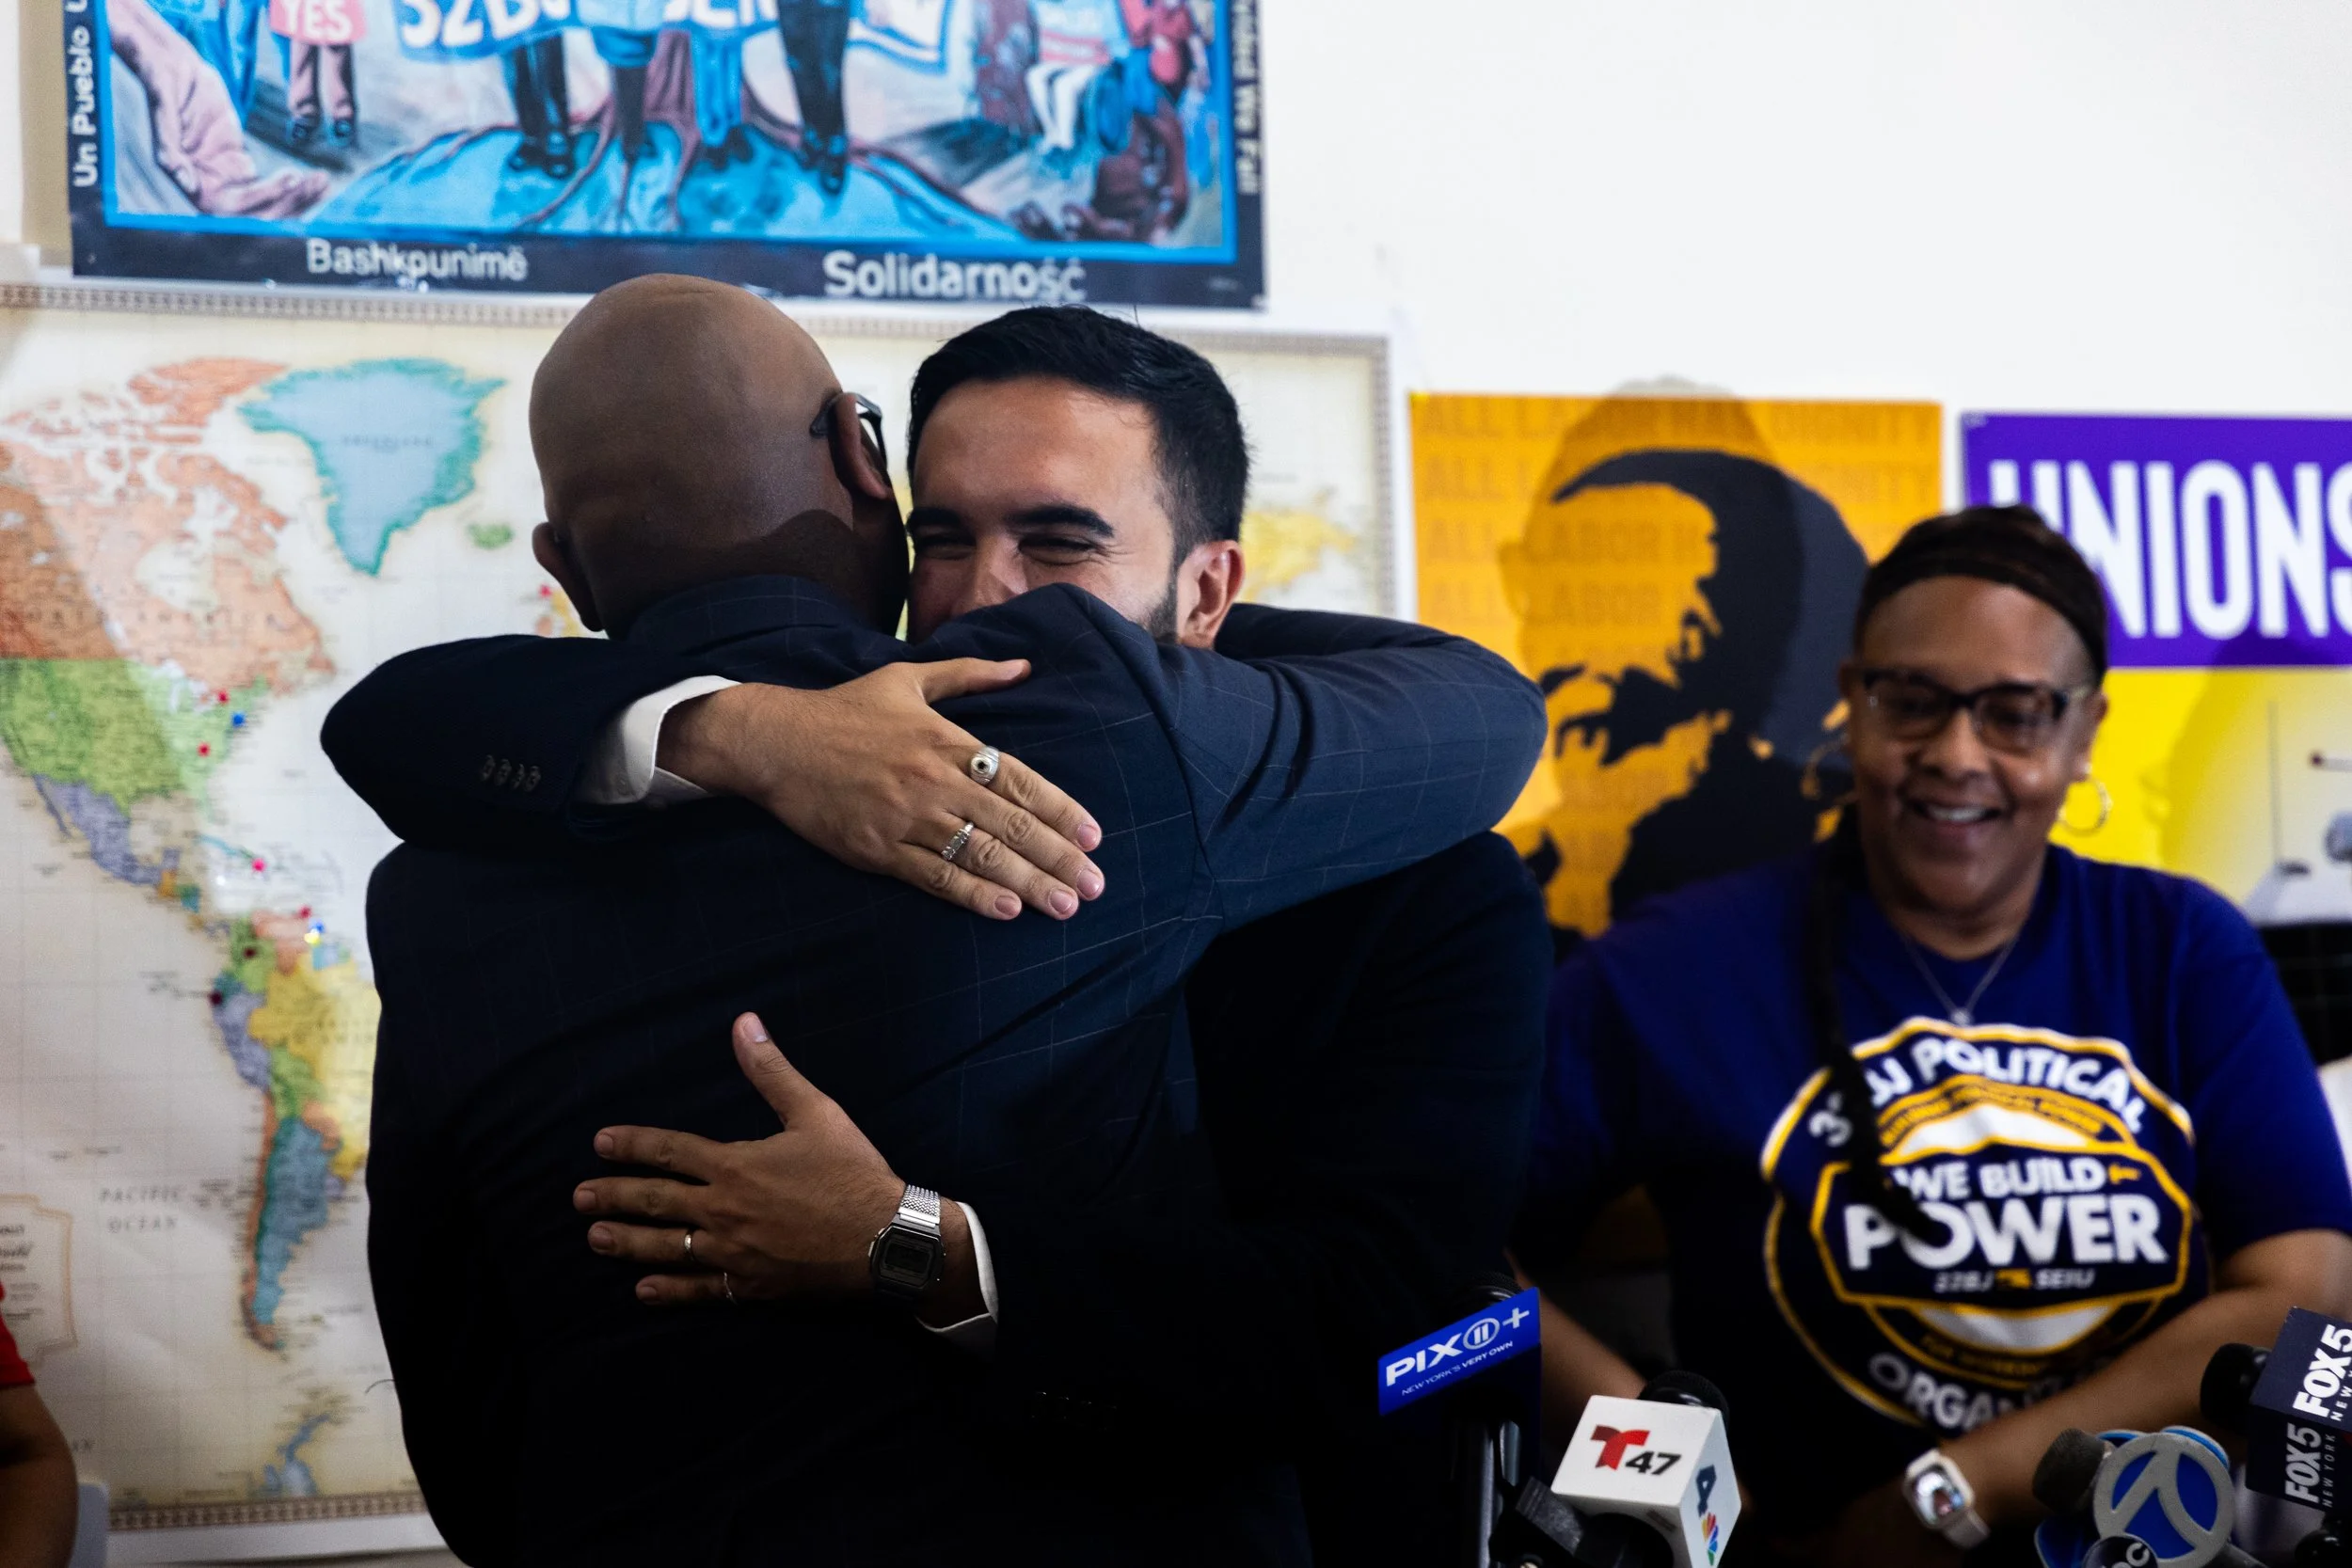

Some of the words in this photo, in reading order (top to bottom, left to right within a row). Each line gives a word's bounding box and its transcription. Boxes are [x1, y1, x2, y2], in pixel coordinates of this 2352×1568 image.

[68, 25, 96, 135] Pueblo
[72, 142, 98, 187] Un
[822, 249, 1087, 303] Solidarność
[1912, 1037, 2146, 1133] POLITICAL
[1892, 1162, 1970, 1201] WE
[1979, 1157, 2106, 1198] BUILD
[1844, 1194, 2169, 1269] POWER
[1402, 1381, 1424, 1396] NEW
[1462, 1353, 1487, 1369] VERY
[1488, 1340, 1514, 1356] OWN
[1626, 1450, 1682, 1476] 47
[2323, 1433, 2336, 1471] YORK
[2322, 1477, 2335, 1508] NEW
